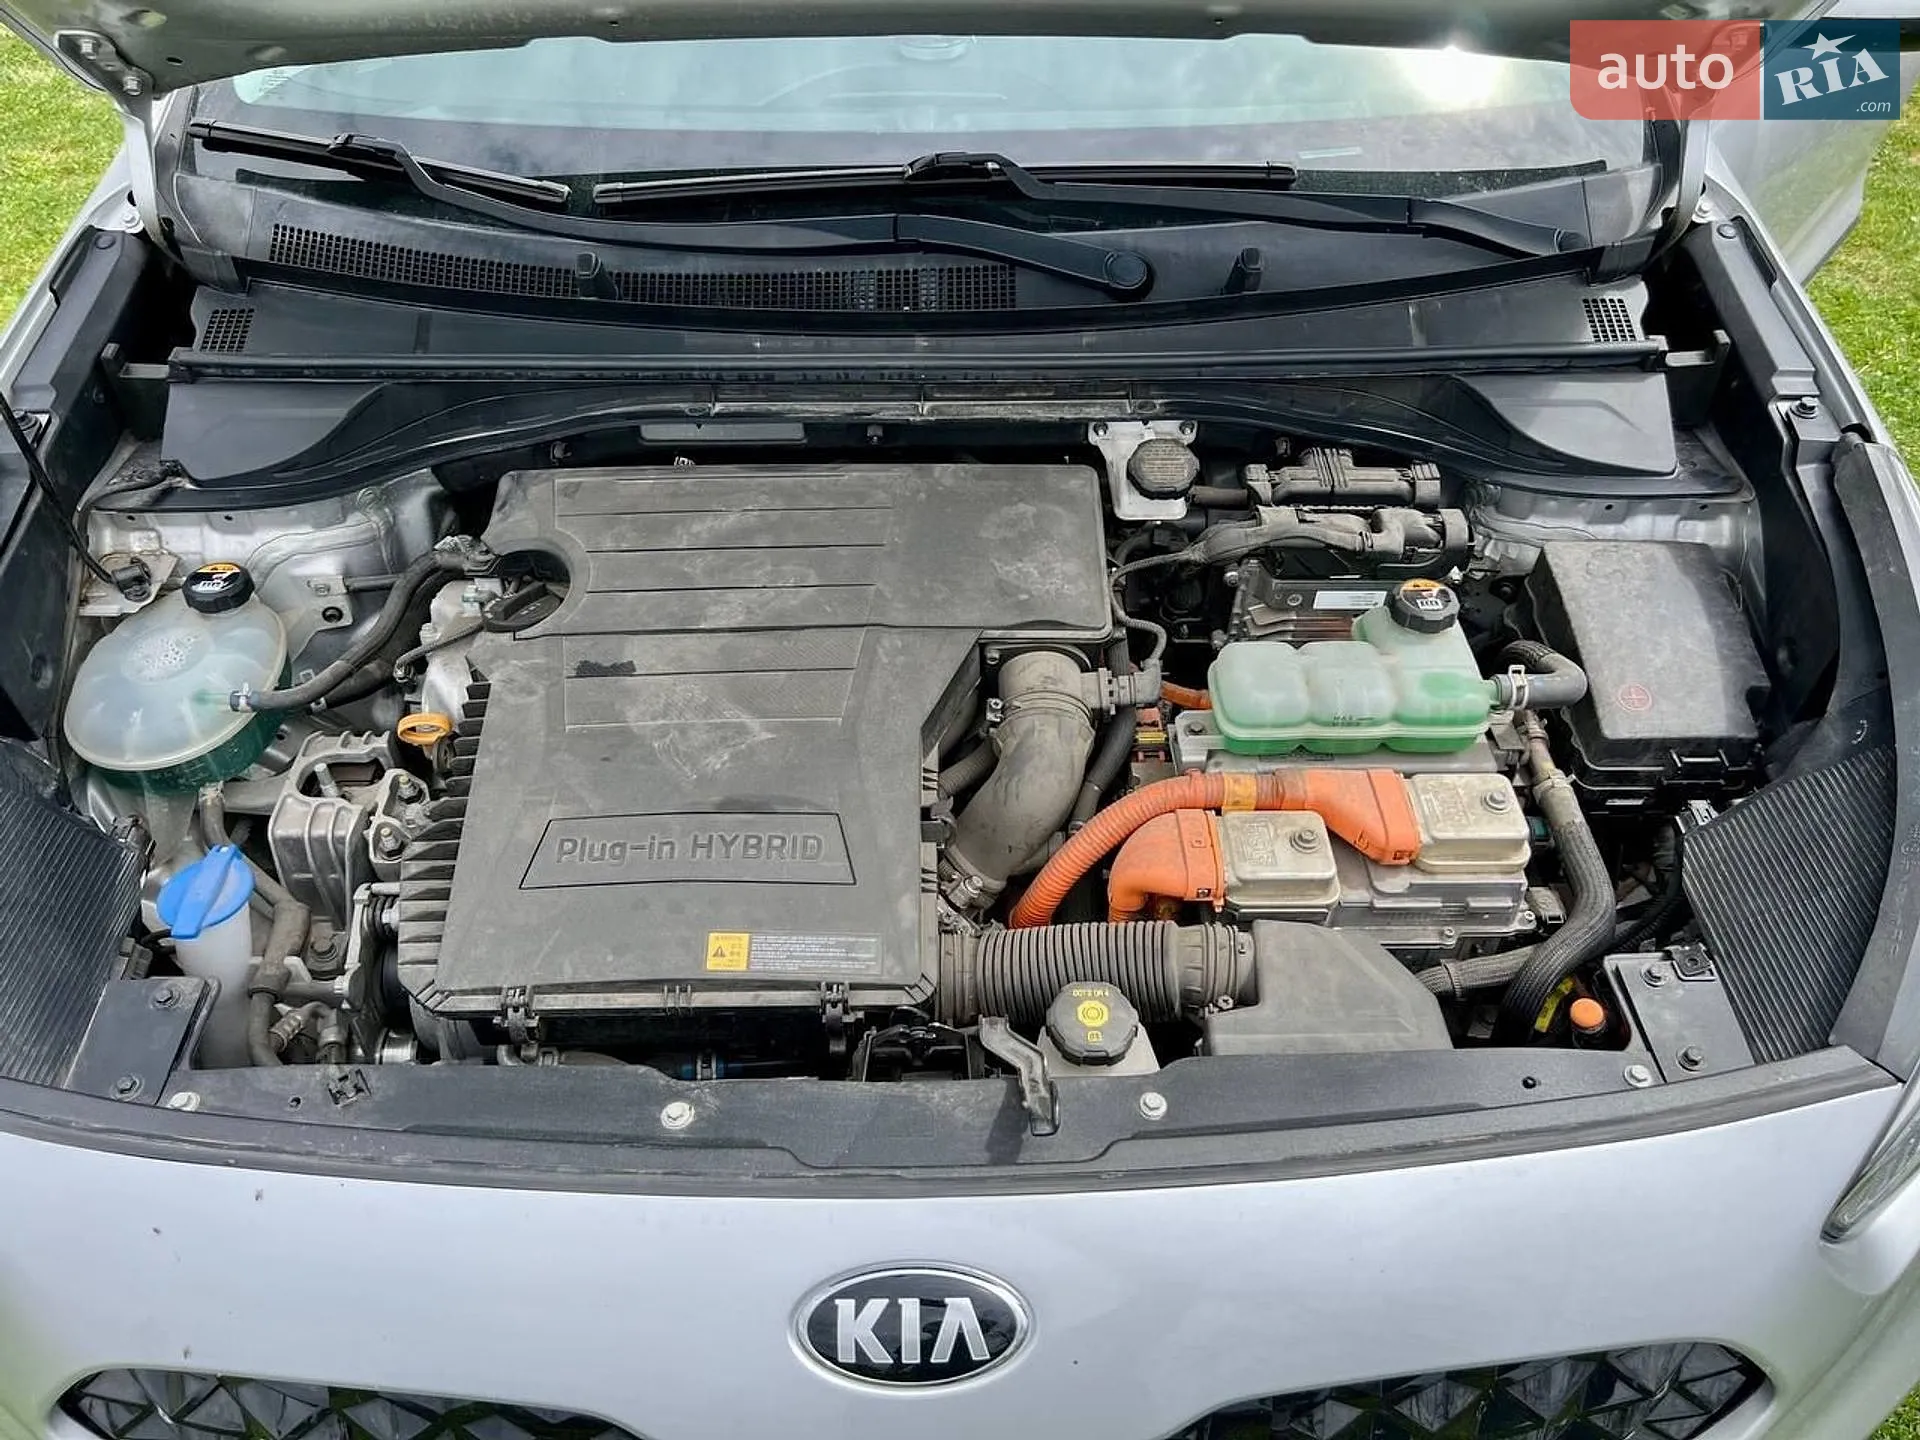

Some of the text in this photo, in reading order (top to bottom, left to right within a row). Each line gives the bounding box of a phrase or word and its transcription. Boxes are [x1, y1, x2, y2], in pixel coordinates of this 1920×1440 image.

[555, 833, 825, 867] Plug-in HYBRID
[834, 1297, 991, 1364] KIA
